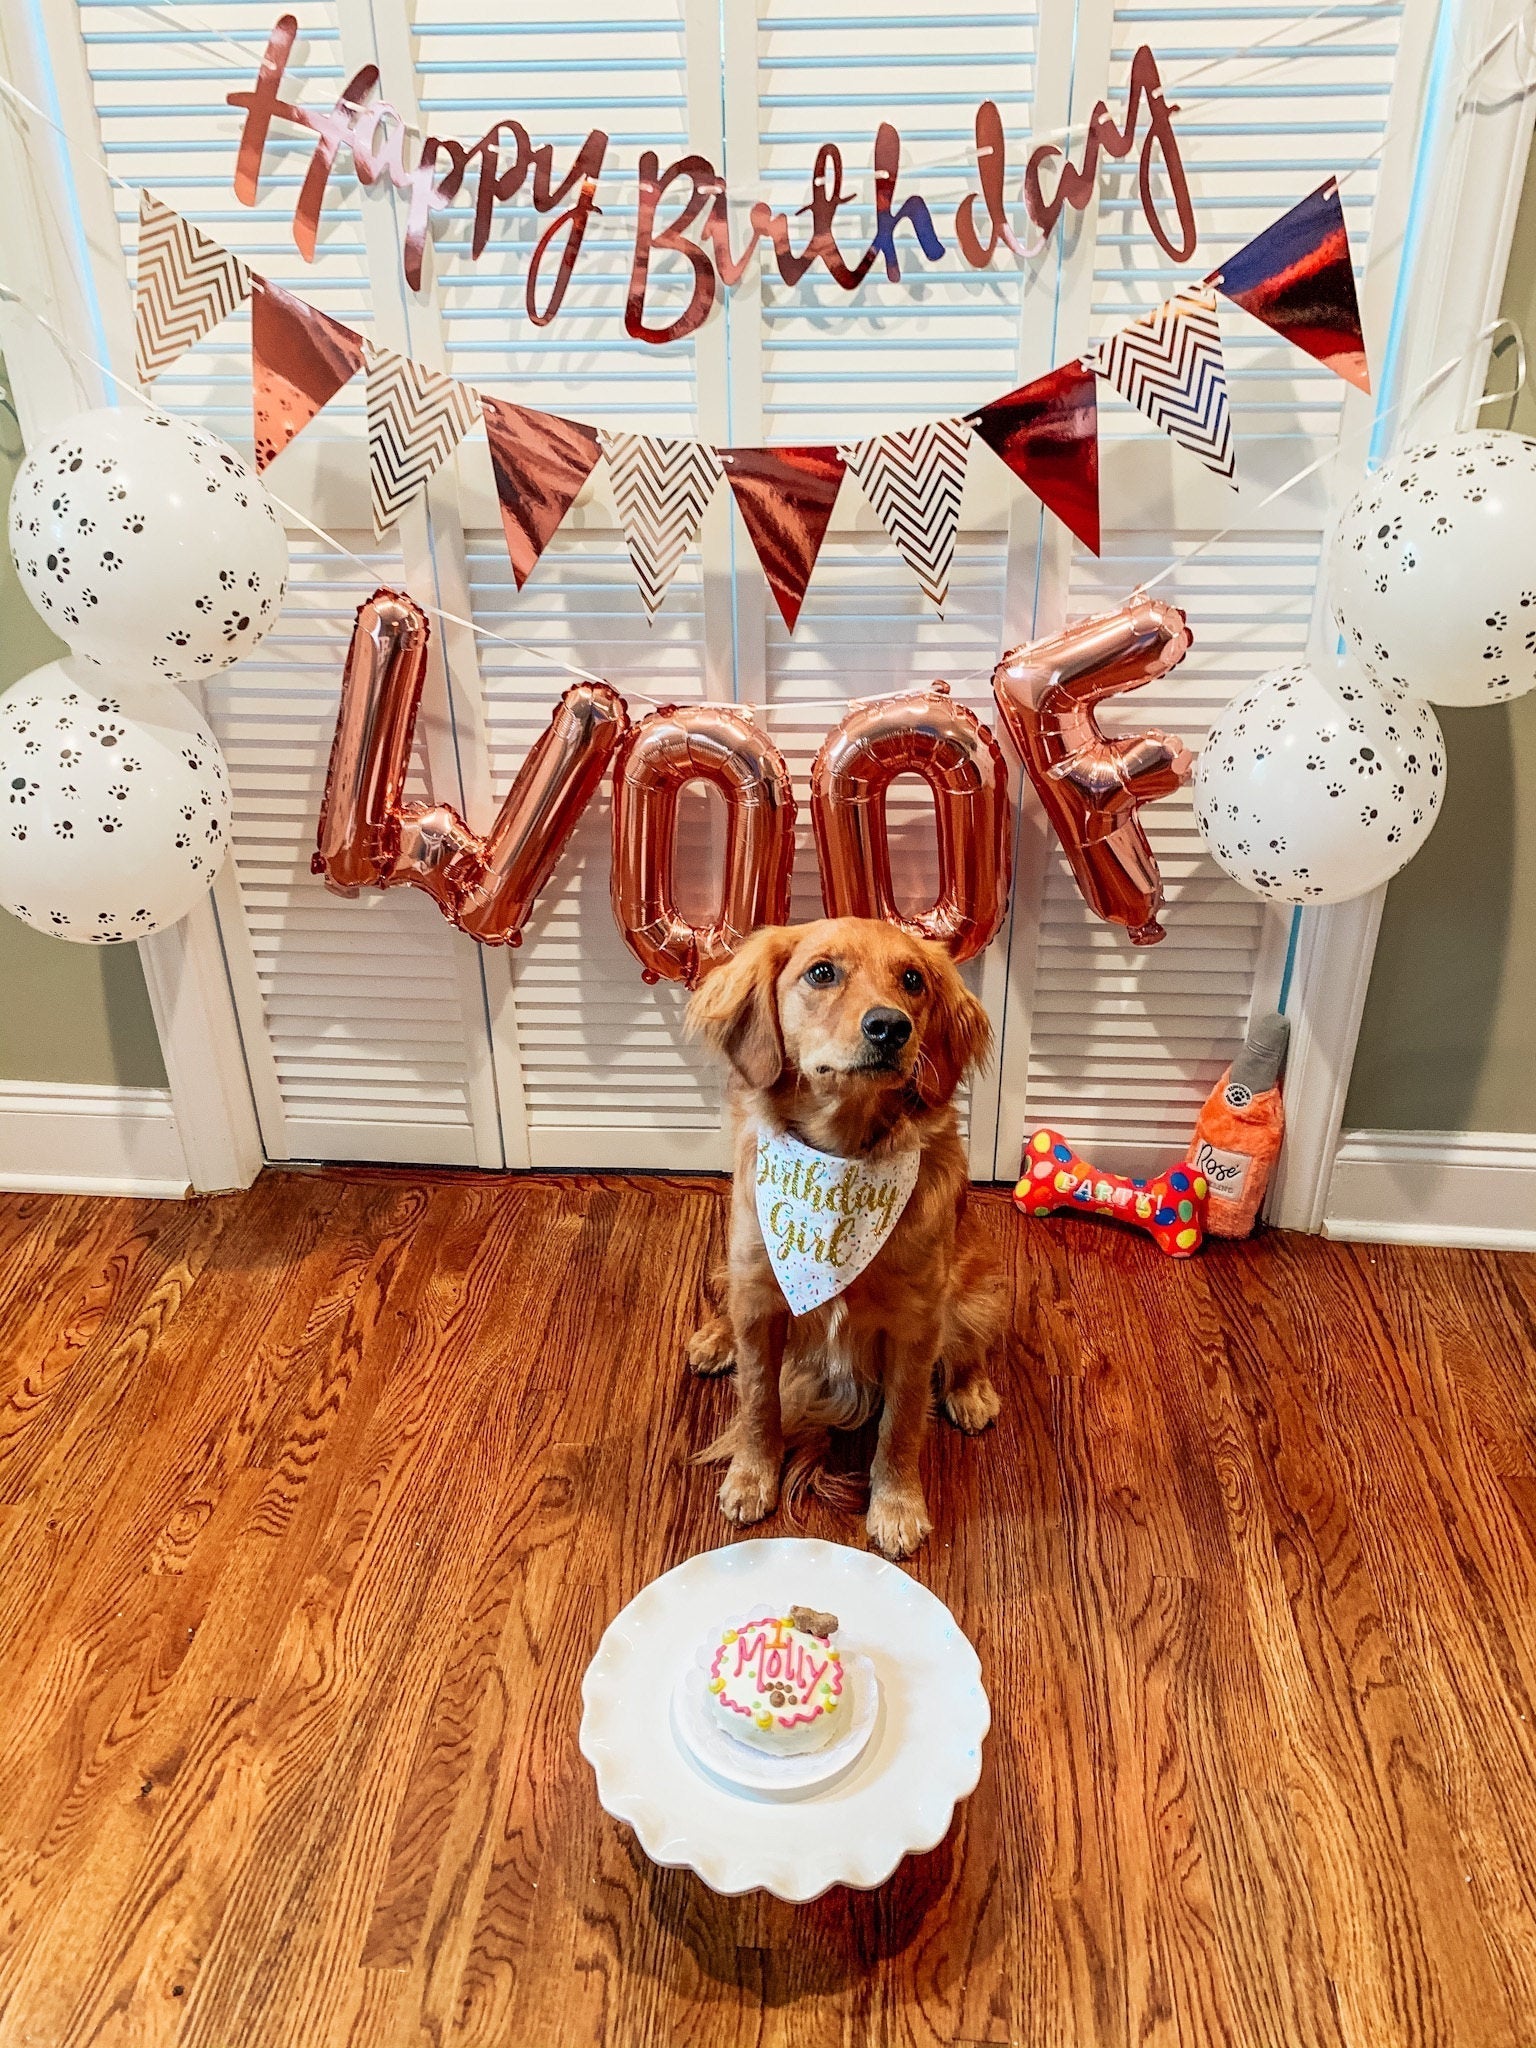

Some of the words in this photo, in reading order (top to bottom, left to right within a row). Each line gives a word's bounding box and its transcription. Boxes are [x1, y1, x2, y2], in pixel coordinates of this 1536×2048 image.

[226, 14, 608, 327] Happy
[625, 44, 1197, 344] Birthday
[309, 587, 1194, 990] WOOF
[1060, 1173, 1163, 1216] PARTY!
[1196, 1144, 1241, 1181] Rosé
[769, 1202, 855, 1268] Girl
[733, 1632, 828, 1704] Molly
